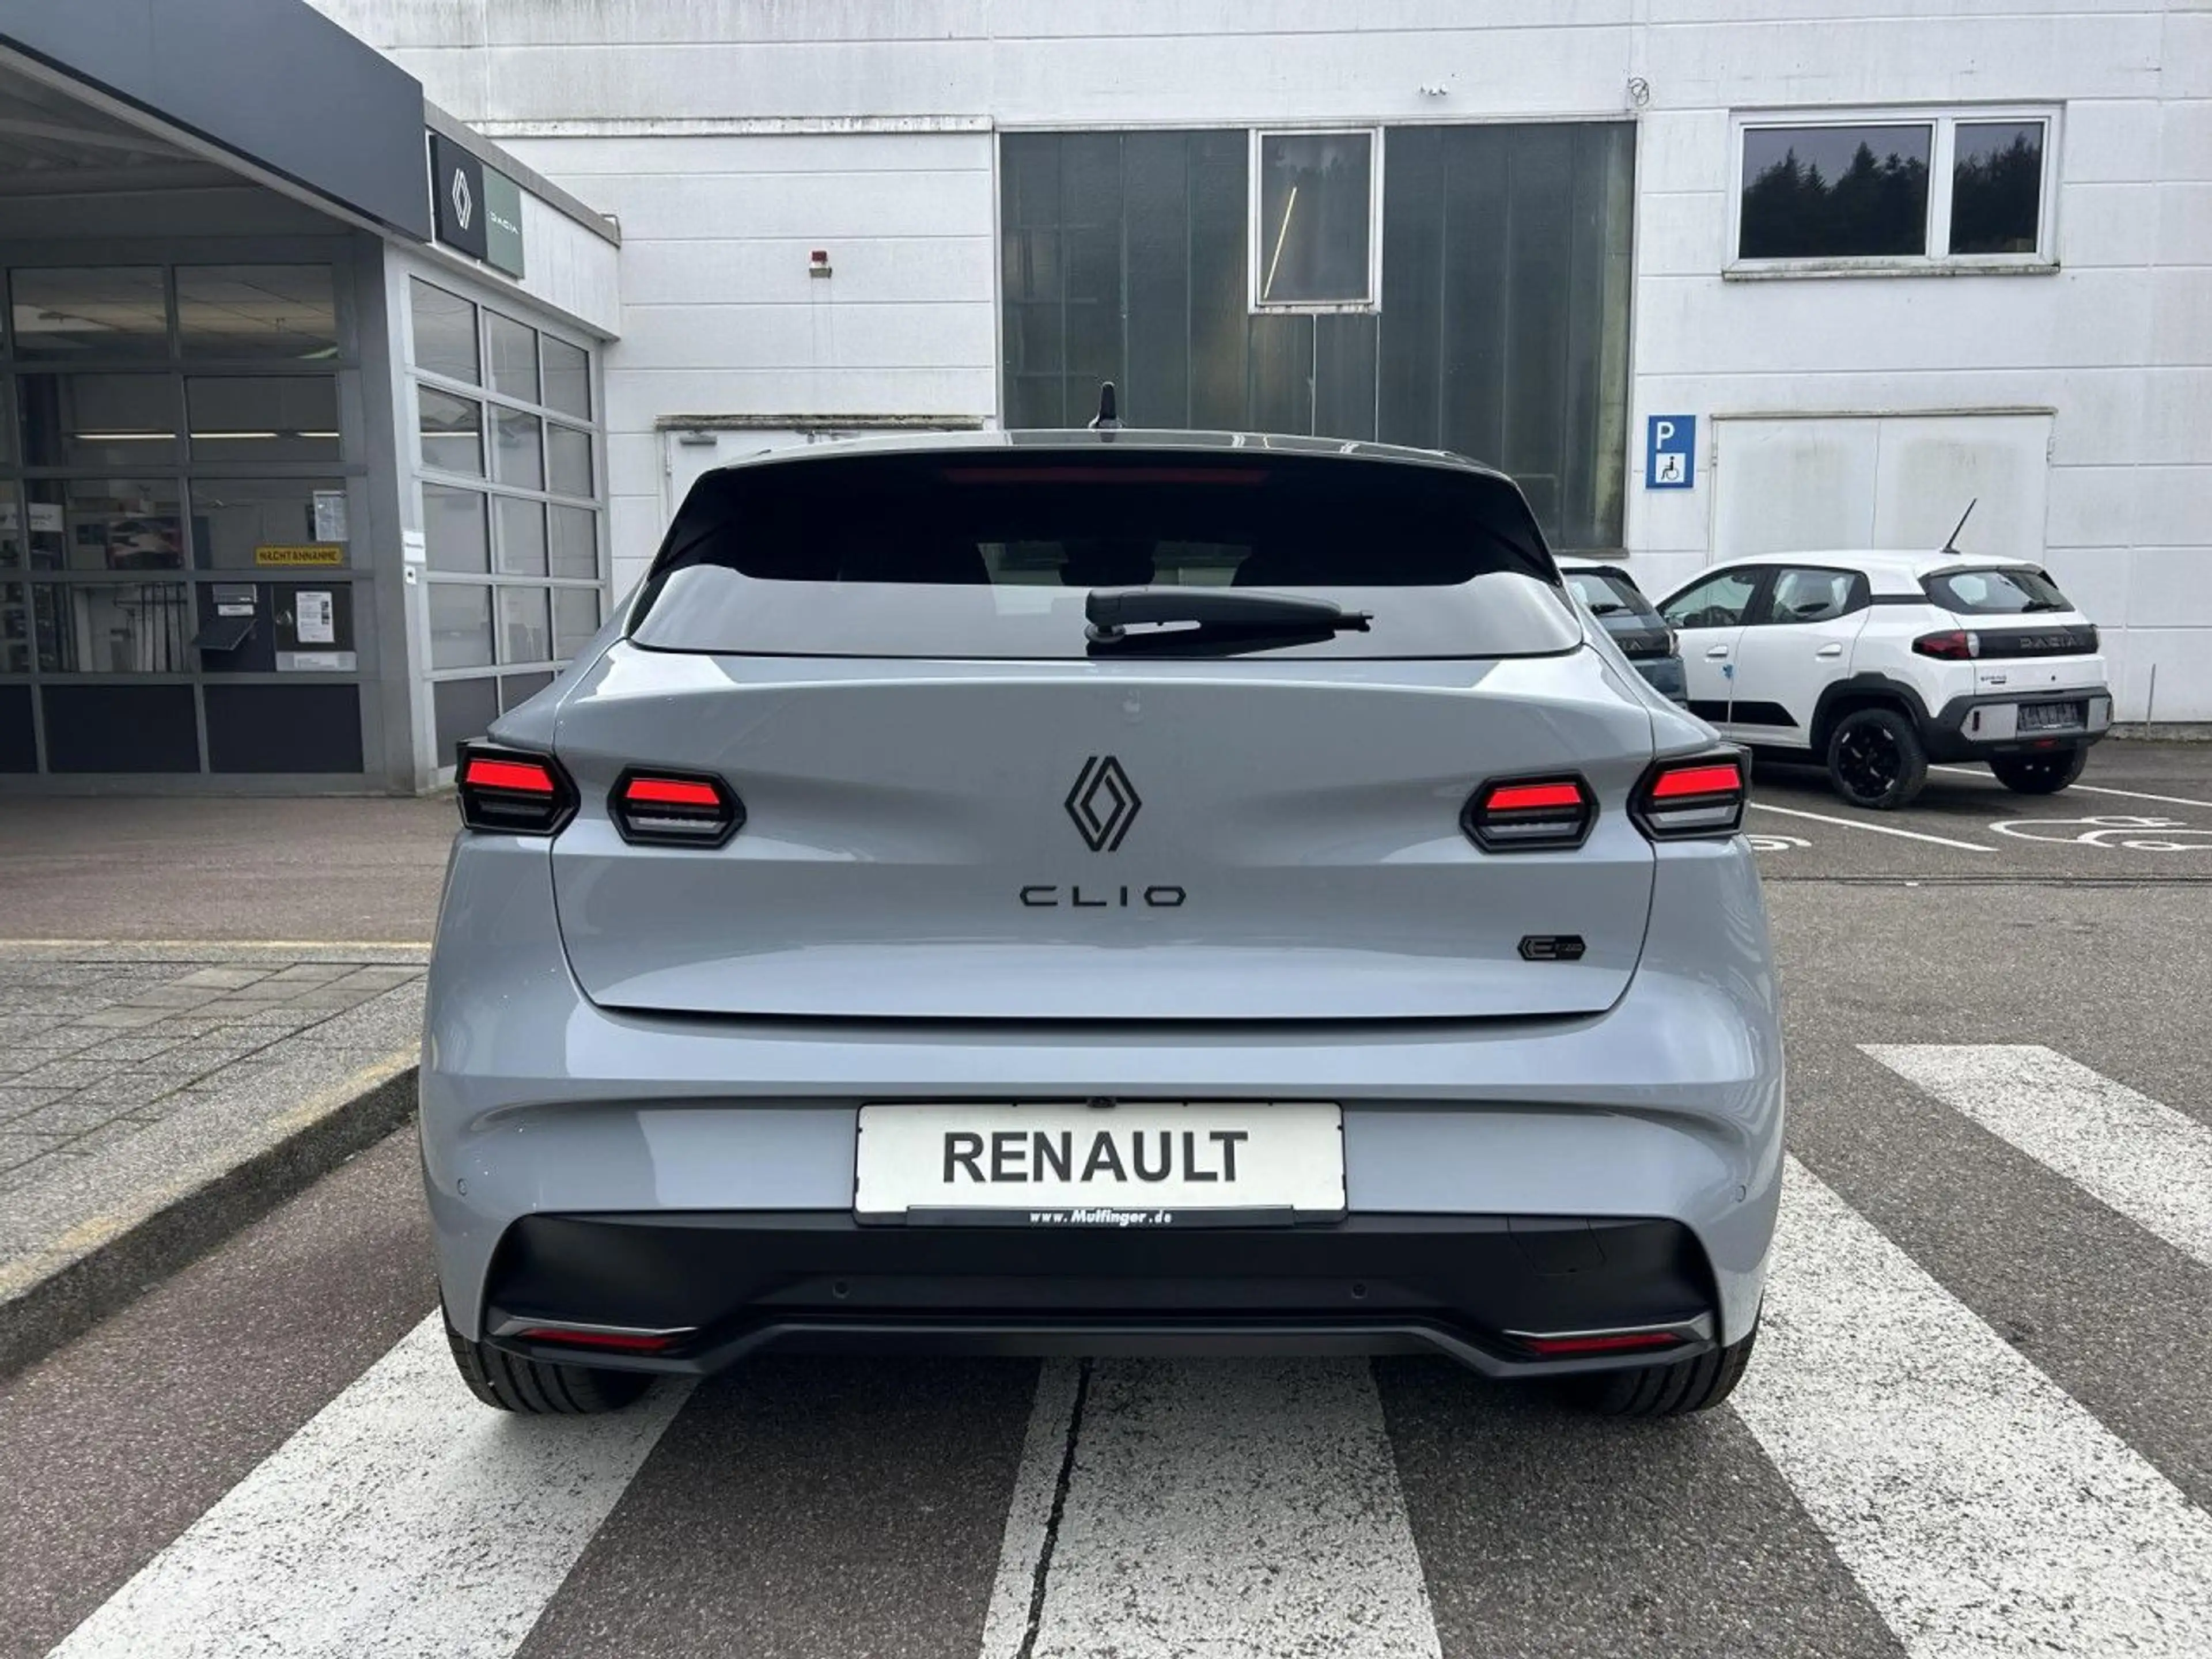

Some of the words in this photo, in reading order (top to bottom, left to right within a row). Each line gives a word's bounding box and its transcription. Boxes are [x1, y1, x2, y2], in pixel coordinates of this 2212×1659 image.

[1656, 421, 1675, 450] P
[2019, 635, 2077, 649] DACIA
[1019, 885, 1187, 907] CLIO
[943, 1131, 1249, 1183] RENAULT
